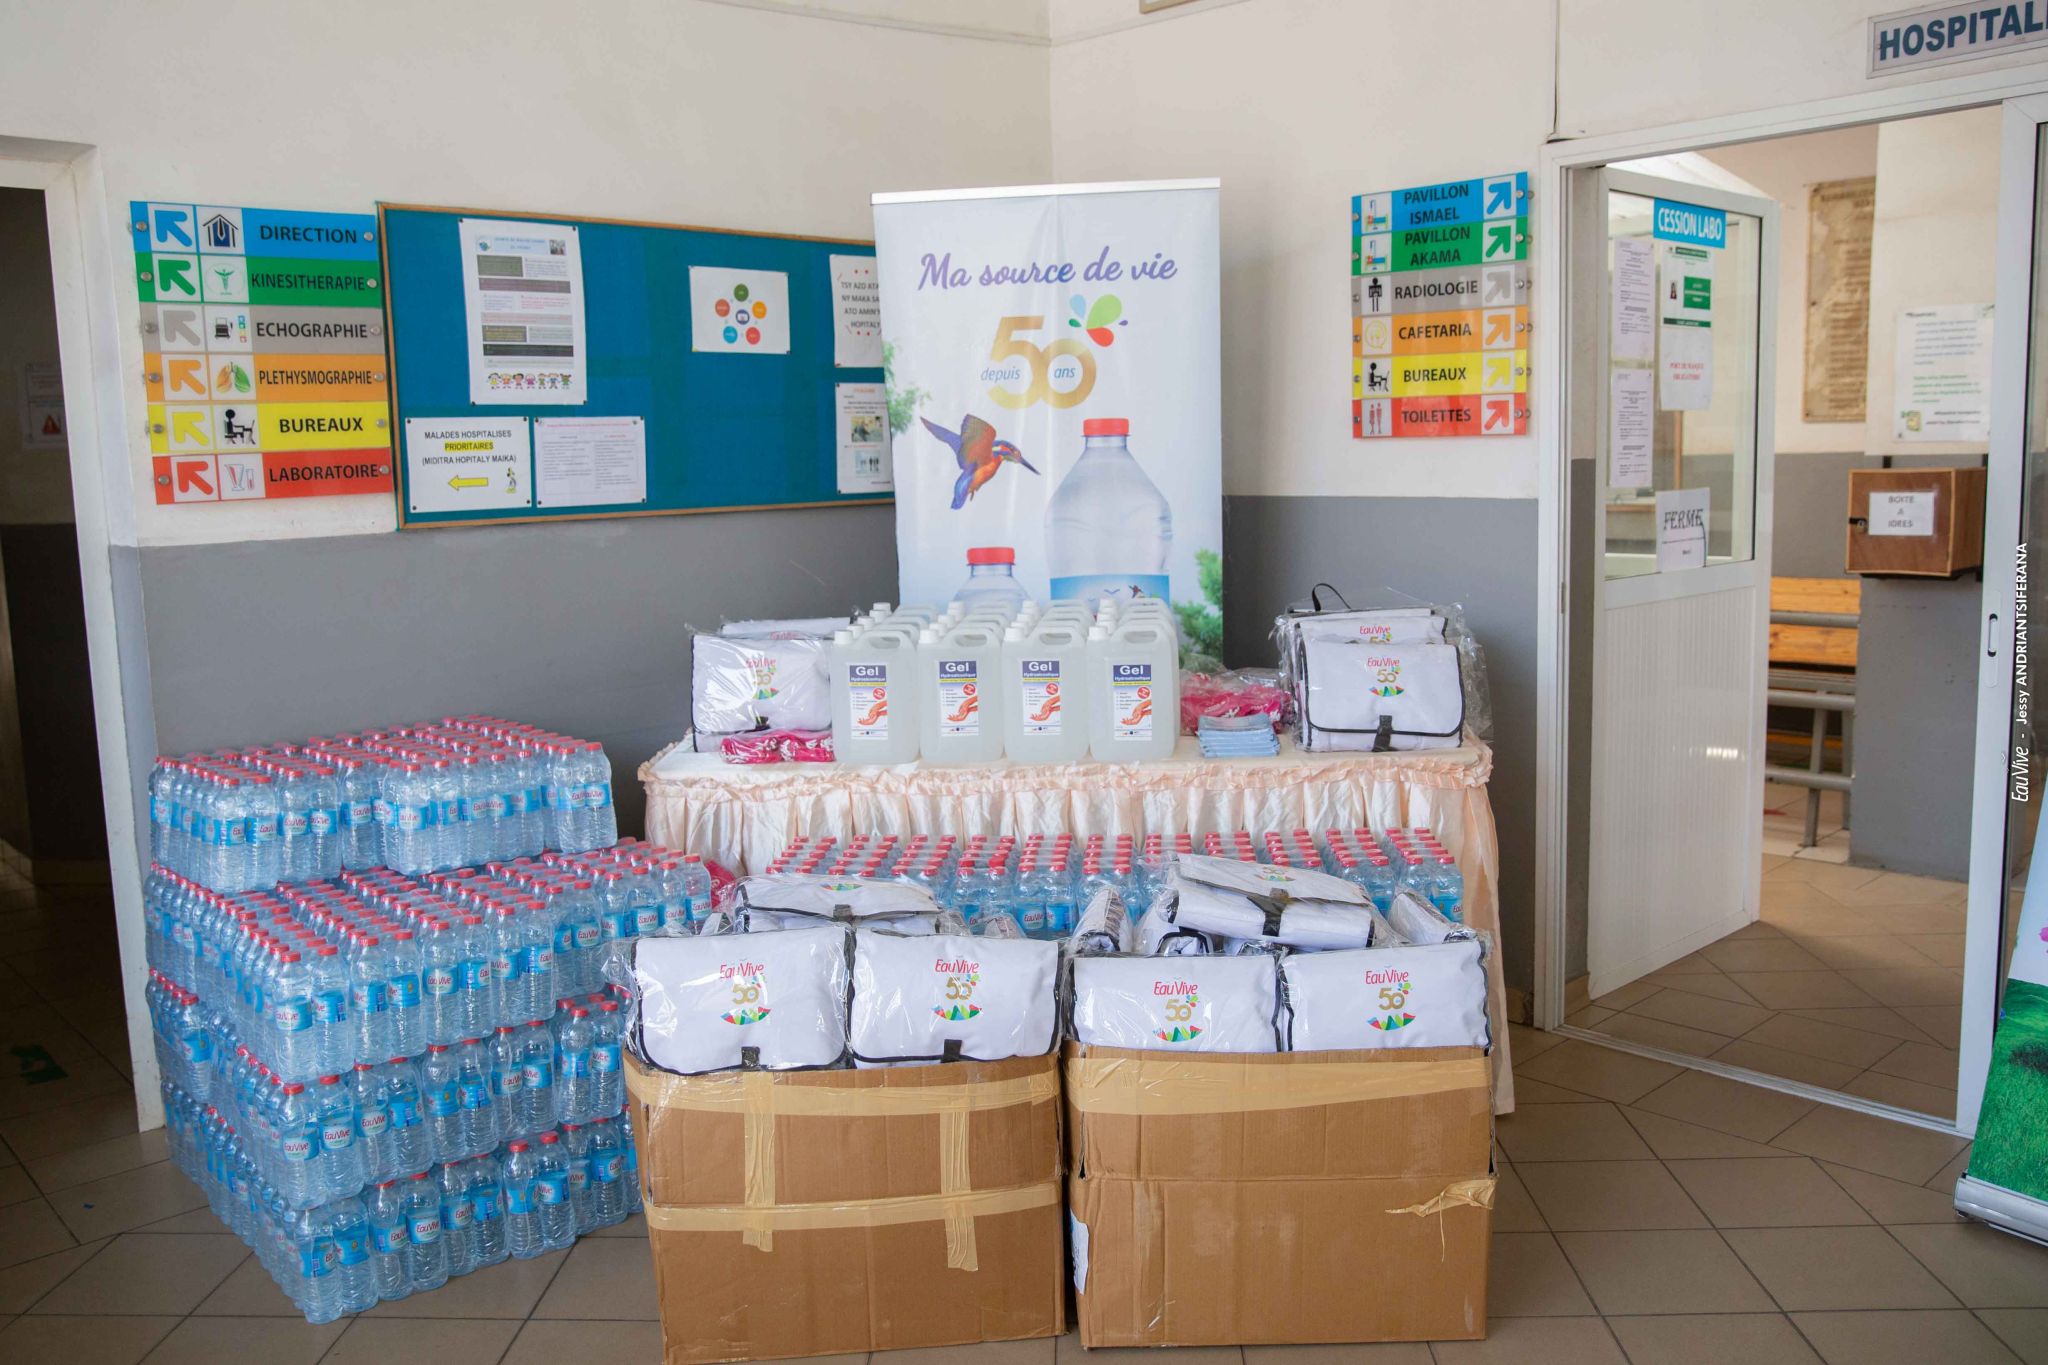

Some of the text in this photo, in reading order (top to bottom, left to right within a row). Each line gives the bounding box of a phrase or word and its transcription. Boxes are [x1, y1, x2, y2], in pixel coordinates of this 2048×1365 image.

[1879, 1, 2048, 61] HOSPITAL
[1404, 184, 1469, 205] PAVILLON
[1410, 207, 1460, 225] ISMAEL
[1657, 207, 1723, 240] CESSION LABO
[260, 225, 357, 243] DIRECTION
[1405, 226, 1471, 246] PAVILLON
[1410, 249, 1461, 266] AKAMA
[917, 246, 1178, 290] Ma source de vie
[251, 273, 365, 291] KINESITHERAPIE
[1394, 280, 1478, 299] RADIOLOGIE
[257, 322, 367, 338] ECHOGRAPHIE
[1399, 323, 1472, 340] CAFETARIA
[980, 315, 1097, 410] depuis 50 ans
[259, 370, 372, 385] PLETHYSMOGRAPHIE
[1403, 367, 1467, 383] BUREAUX
[1402, 407, 1472, 424] TOILETTES
[279, 417, 363, 433] BUREAUX
[424, 430, 512, 440] MALADES HOSPITALISES
[444, 442, 494, 451] PRIORITAIRES
[422, 456, 454, 466] (MIDITRA
[455, 455, 490, 465] HOPITALY
[269, 464, 378, 482] LABORATOIRE
[1360, 625, 1391, 635] EauVive
[945, 662, 969, 672] Gel
[1028, 662, 1052, 672] Gel
[1367, 656, 1399, 667] EauVive
[856, 666, 879, 676] Gel
[1120, 665, 1144, 675] Gel
[1376, 669, 1397, 683] 50
[720, 962, 764, 978] EauVive
[935, 959, 979, 973] EauVive
[1365, 969, 1409, 984] EauVive
[945, 977, 972, 1000] 50
[1153, 981, 1198, 995] EauVive
[1379, 988, 1405, 1010] 50
[1165, 999, 1191, 1021] 50
